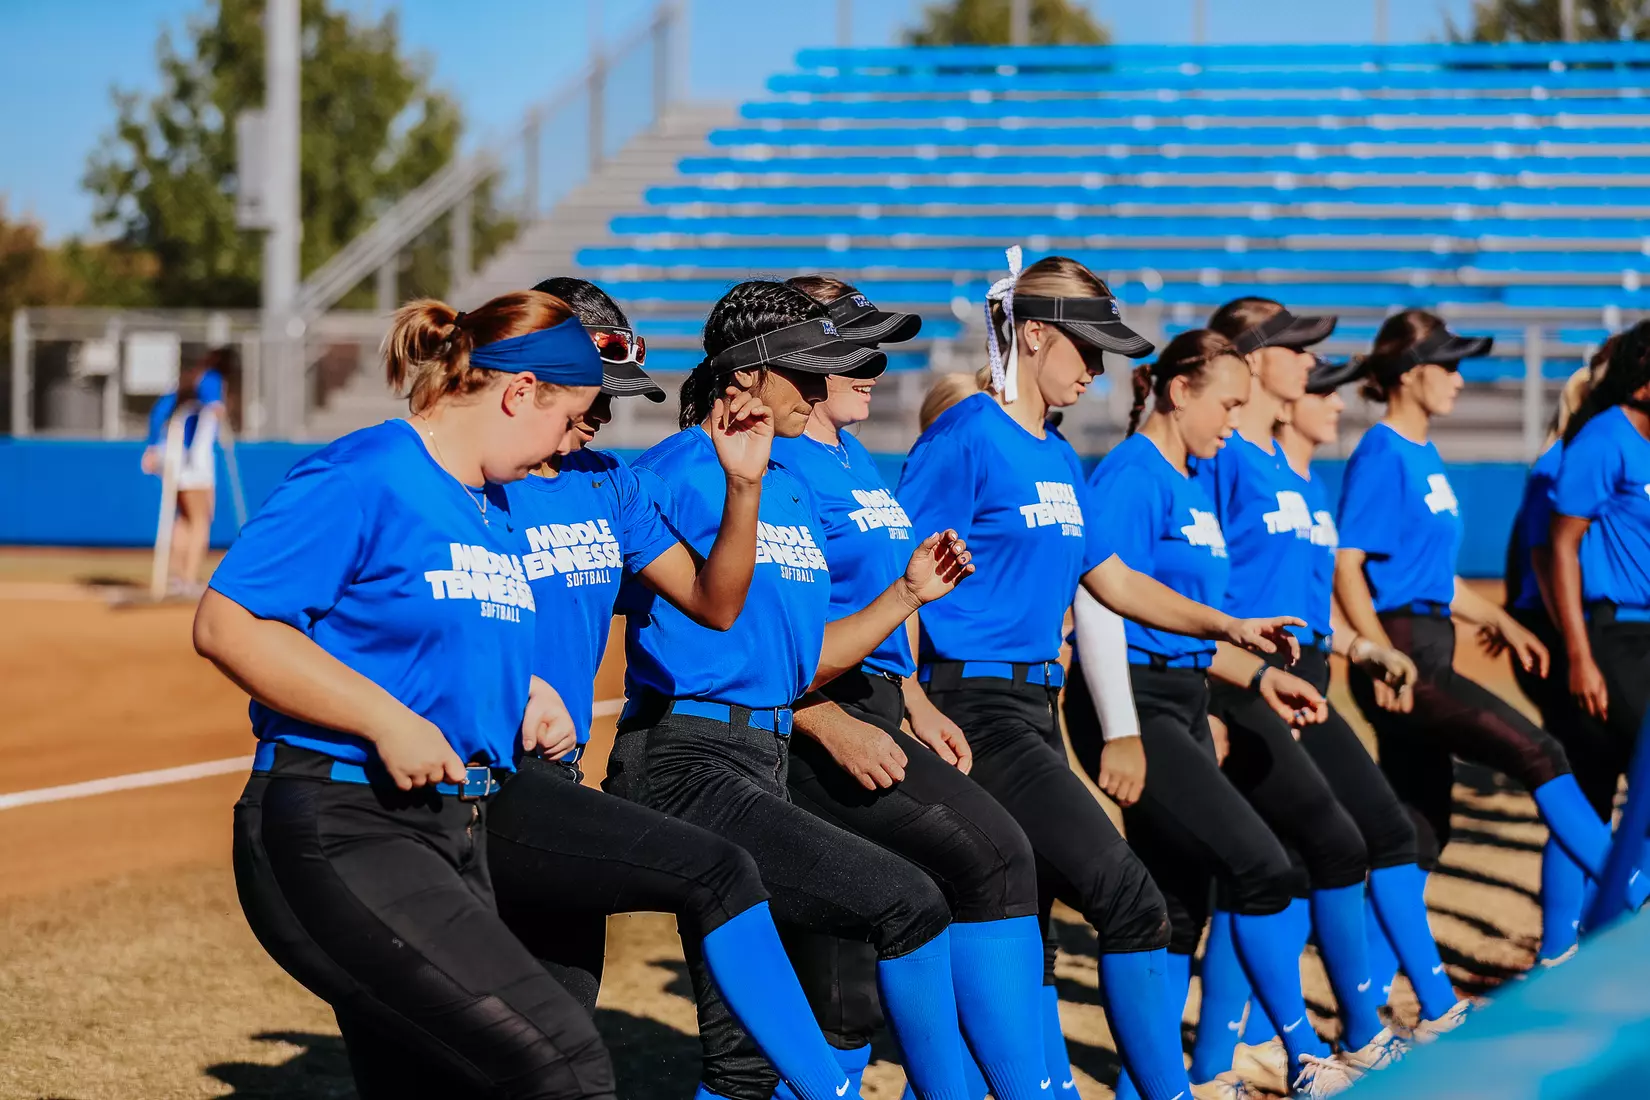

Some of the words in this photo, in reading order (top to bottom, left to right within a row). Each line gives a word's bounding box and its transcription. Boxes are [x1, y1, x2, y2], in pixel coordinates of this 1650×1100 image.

[525, 518, 617, 553] MIDDLE
[522, 542, 624, 581] ENNESSE
[780, 565, 815, 583] SOFTBALL
[424, 569, 537, 613] TENNESSE
[565, 569, 611, 588] SOFTBALL
[480, 601, 521, 624] SOFTBALL
